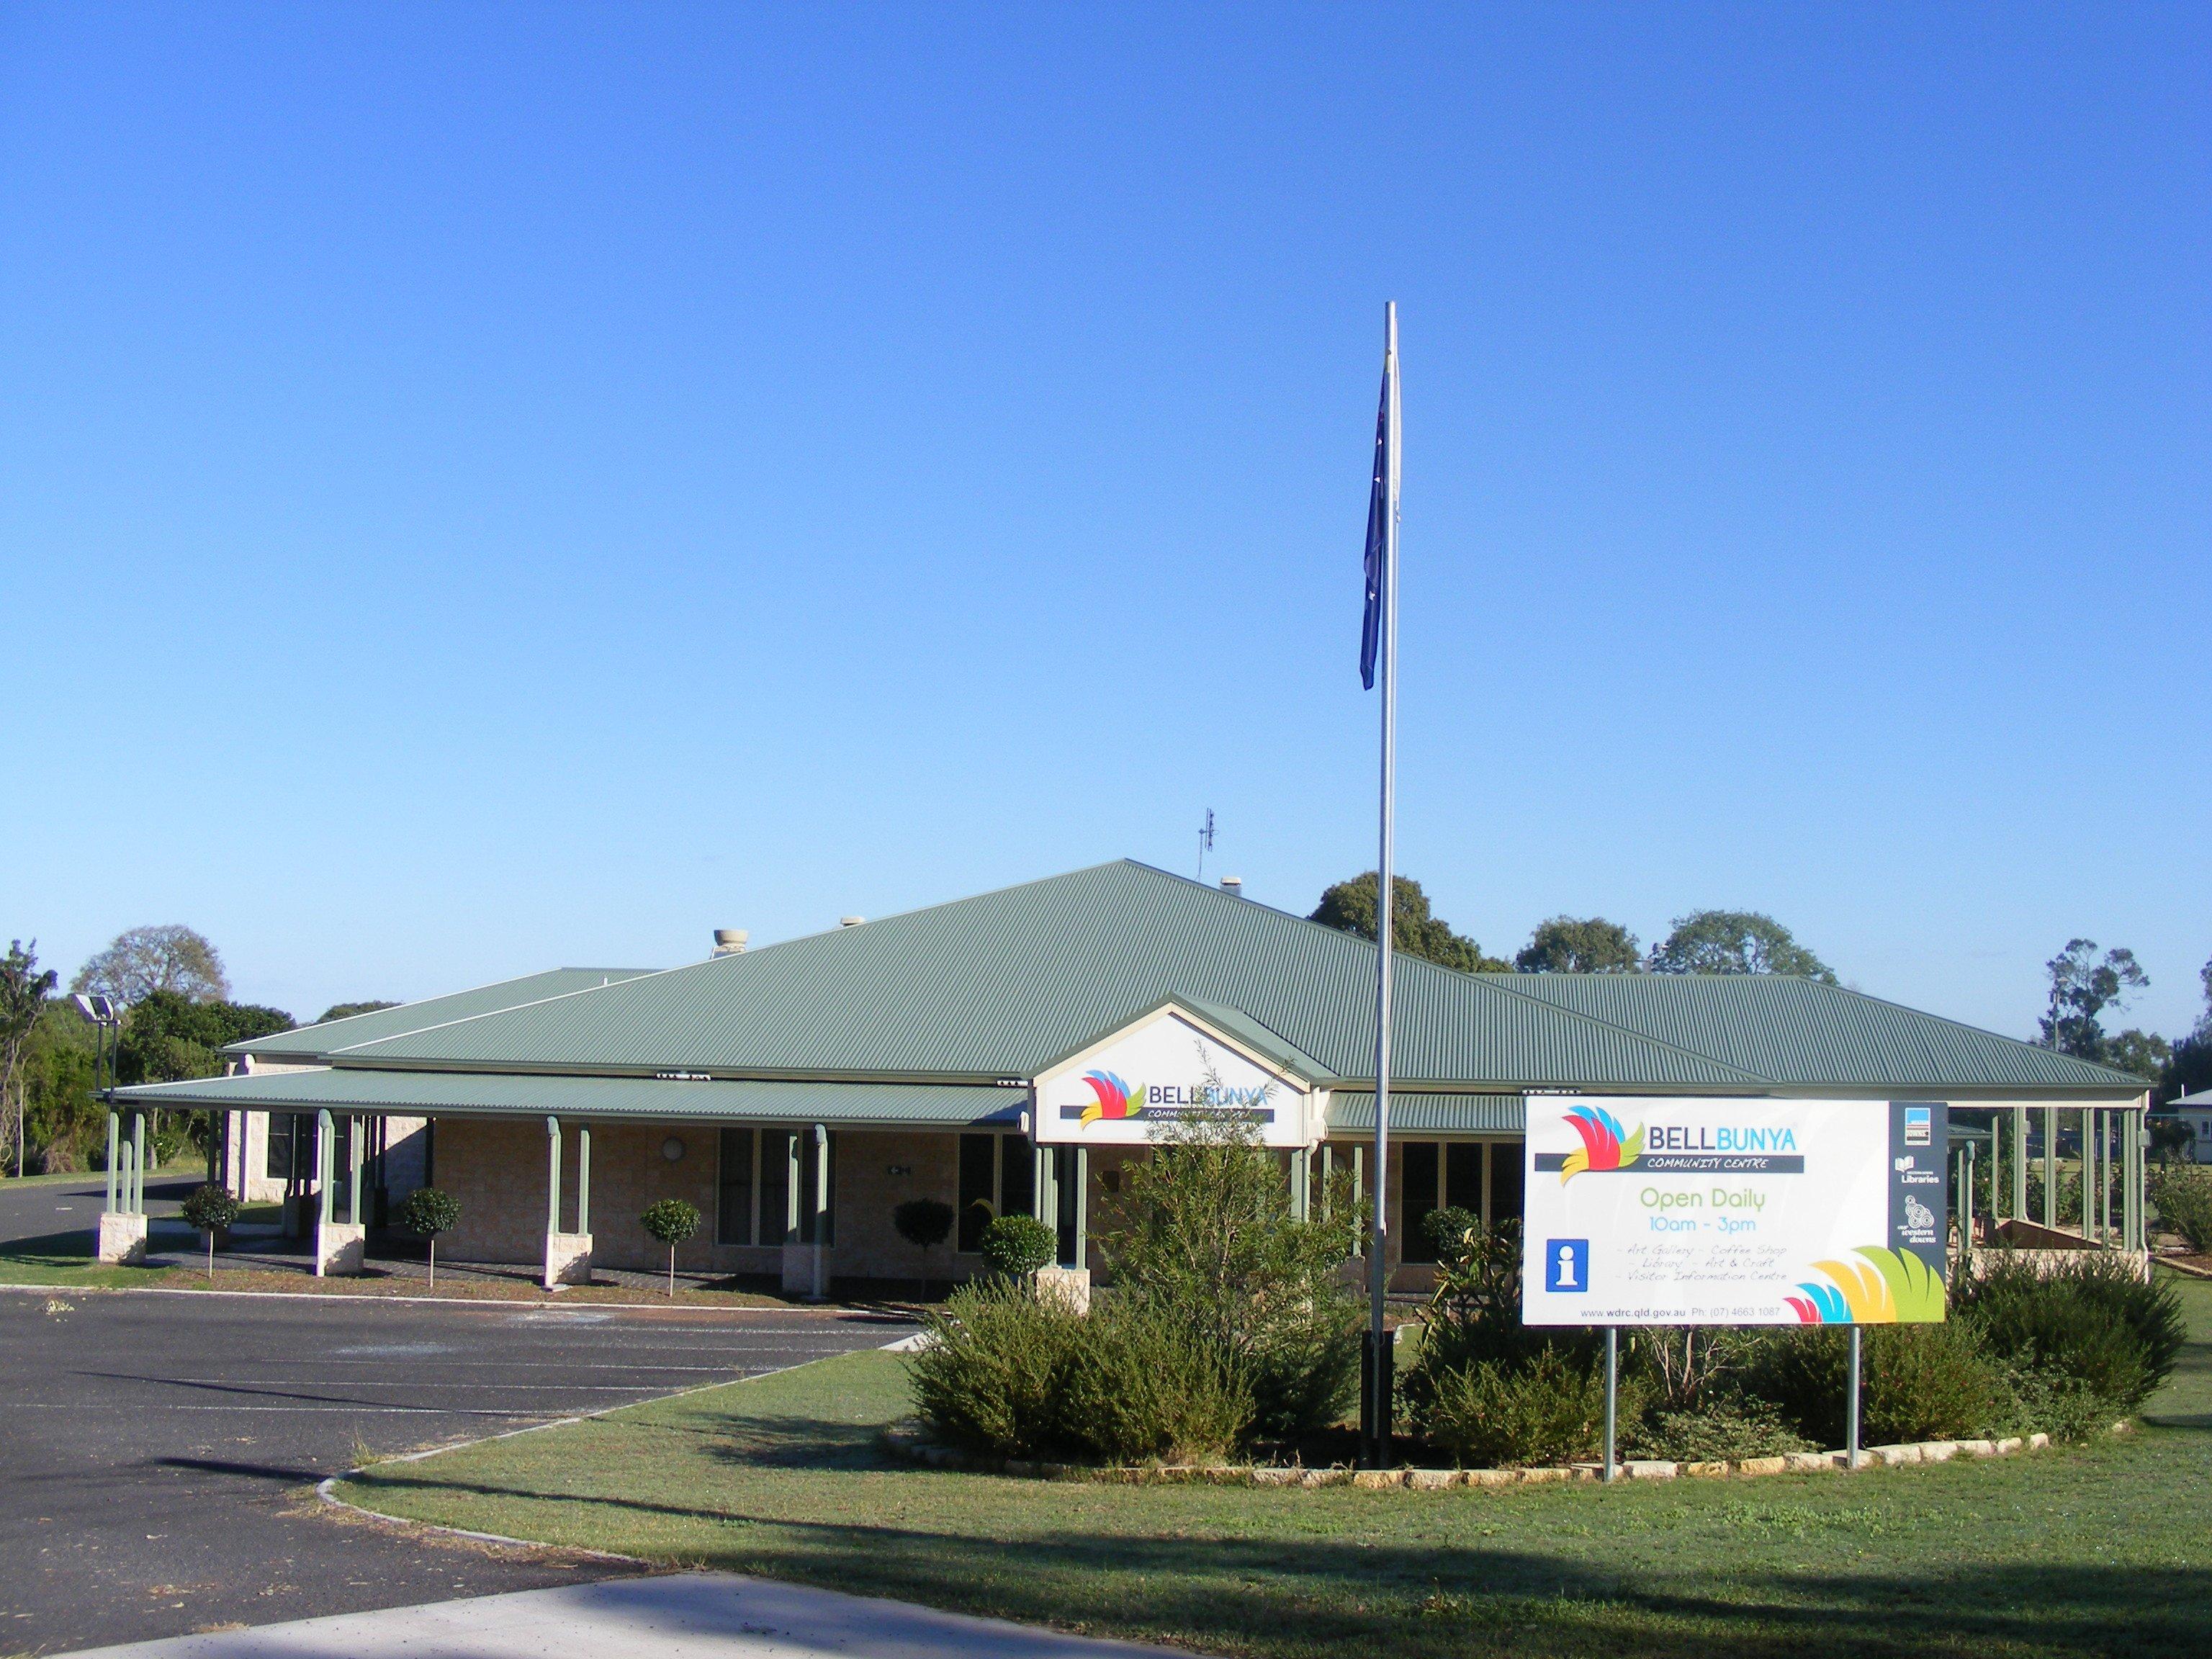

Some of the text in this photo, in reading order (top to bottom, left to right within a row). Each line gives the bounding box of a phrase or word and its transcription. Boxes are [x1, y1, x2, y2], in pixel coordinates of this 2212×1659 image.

[1647, 1157, 1769, 1169] COMMUNITY CENTRE
[1901, 1174, 1940, 1184] Libraries
[1640, 1187, 1766, 1213] Open Daily
[1650, 1215, 1696, 1232] 10am
[1717, 1216, 1756, 1234] 3pm
[1627, 1244, 1788, 1259] Art Gallery Coffee Shop
[1642, 1257, 1683, 1271] Library
[1705, 1256, 1724, 1268] Art
[1743, 1257, 1776, 1268] Craft
[1627, 1269, 1788, 1282] Visitor Information Centre
[1580, 1307, 1686, 1320] www.wdrc.qld.gov.au
[1731, 1307, 1755, 1318] 4663
[1758, 1306, 1781, 1317] 1087
